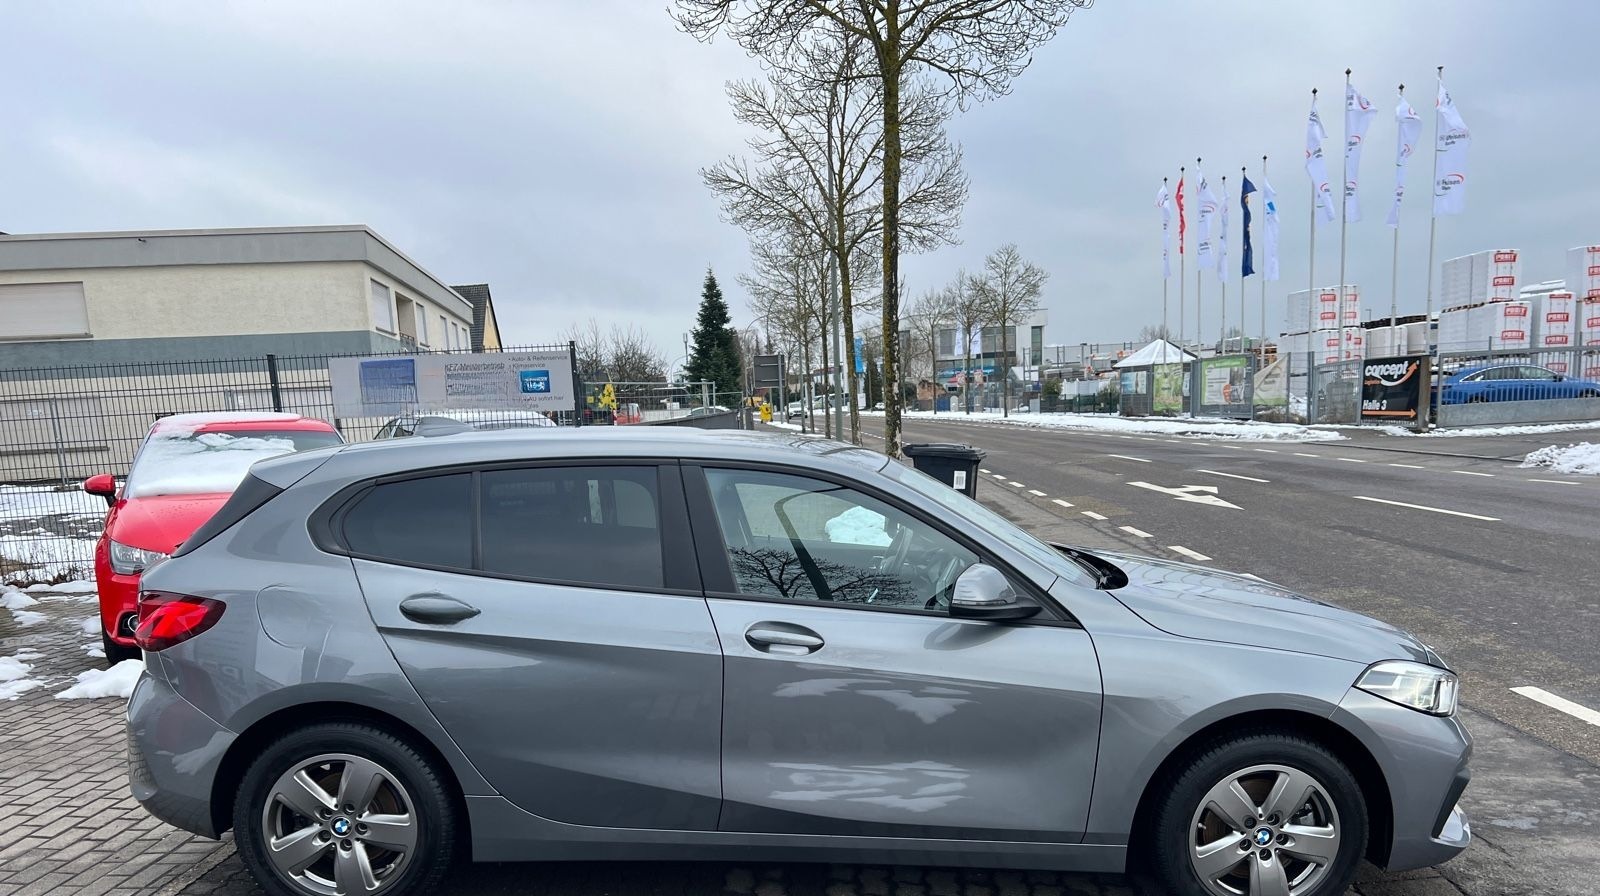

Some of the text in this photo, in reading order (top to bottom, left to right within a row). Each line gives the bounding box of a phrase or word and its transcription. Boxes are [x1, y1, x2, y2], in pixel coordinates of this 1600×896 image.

[1364, 360, 1409, 379] concept
[1362, 399, 1387, 410] Halle 3
